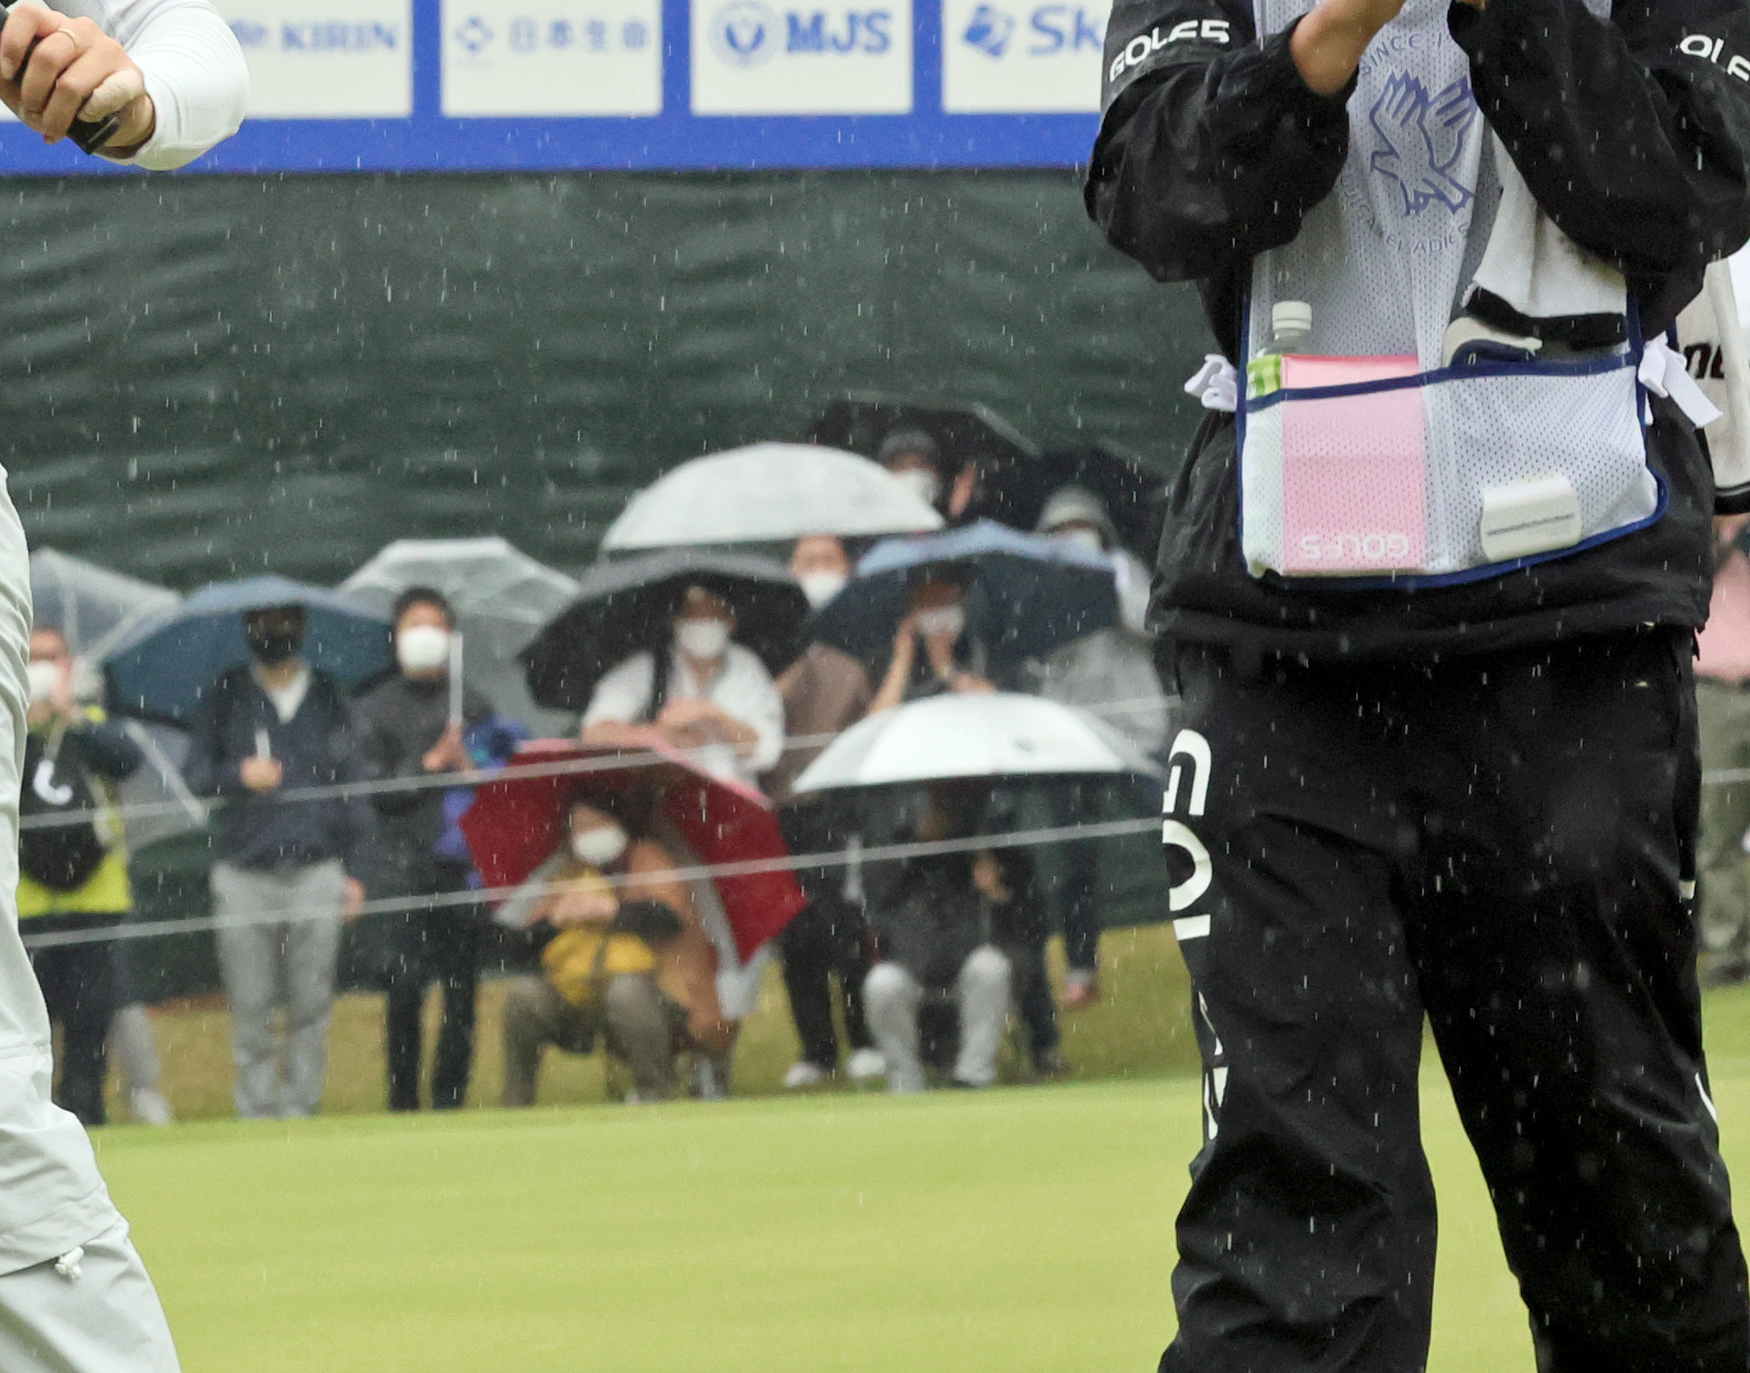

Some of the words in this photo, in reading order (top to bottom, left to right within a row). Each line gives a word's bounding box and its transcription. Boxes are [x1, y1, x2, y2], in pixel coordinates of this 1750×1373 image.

[280, 17, 400, 55] KIRIN
[785, 8, 895, 56] MJS
[1026, 1, 1104, 56] Sk
